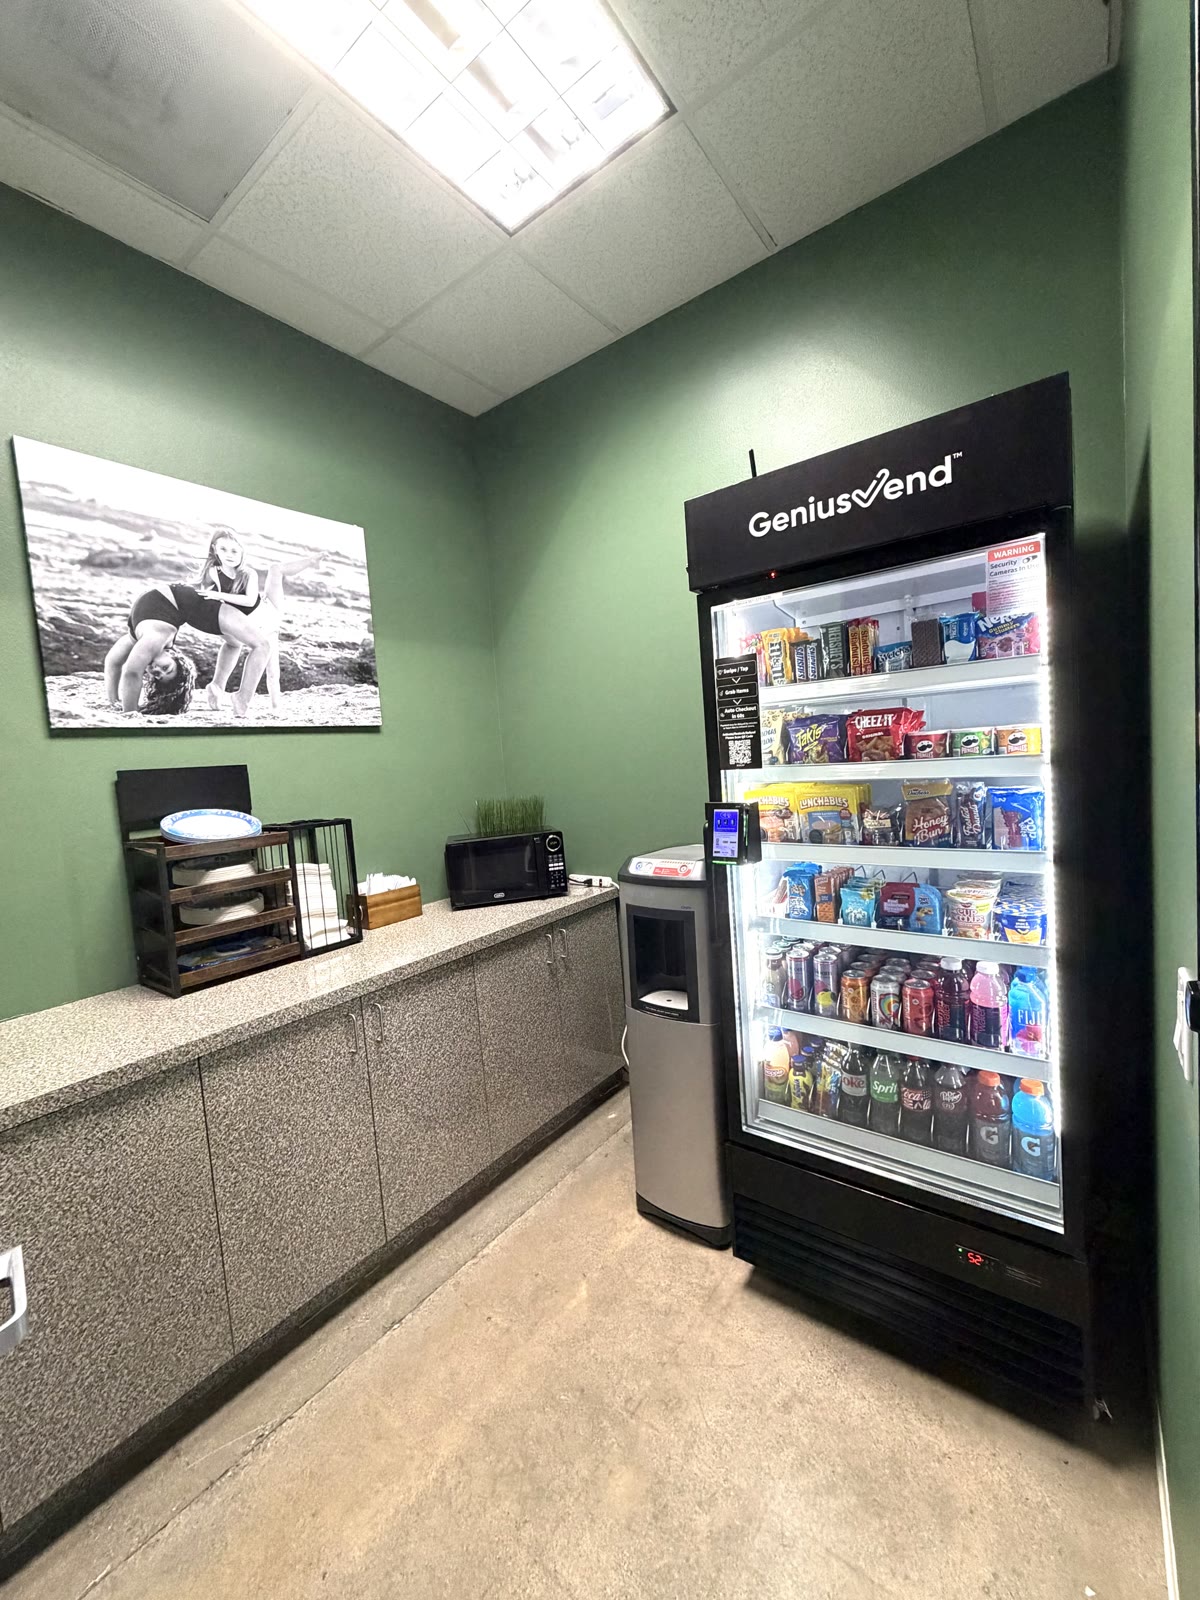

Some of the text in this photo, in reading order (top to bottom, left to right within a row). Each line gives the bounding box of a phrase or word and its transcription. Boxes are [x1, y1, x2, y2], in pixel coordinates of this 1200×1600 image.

[993, 544, 1035, 559] WARNING
[989, 567, 1018, 577] Cameras
[990, 559, 1018, 570] Security
[828, 626, 844, 670] HERSHEY'S
[795, 723, 823, 751] Takis
[800, 796, 848, 810] LUNCHABLES
[912, 815, 949, 832] Honey
[917, 828, 943, 843] Bun
[1017, 1009, 1042, 1026] FIJI
[872, 1080, 897, 1094] Sprit
[979, 1126, 999, 1145] G
[1020, 1136, 1041, 1157] G
